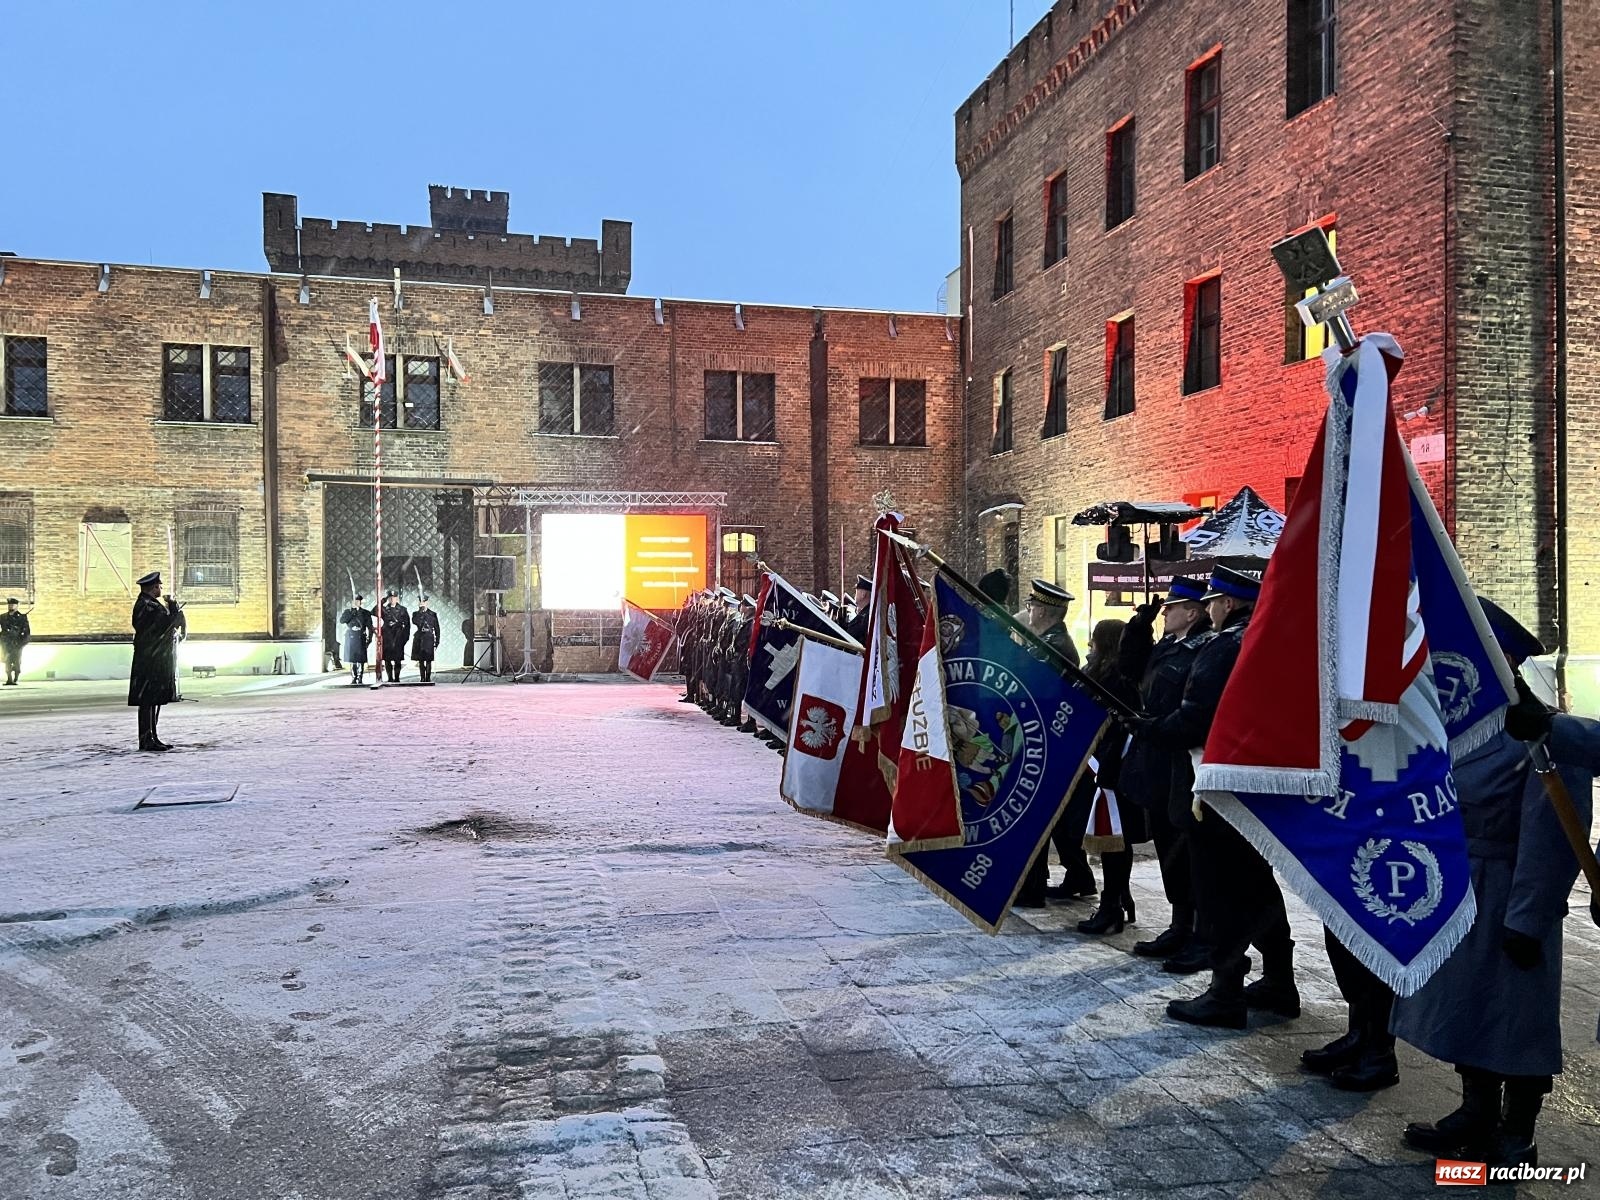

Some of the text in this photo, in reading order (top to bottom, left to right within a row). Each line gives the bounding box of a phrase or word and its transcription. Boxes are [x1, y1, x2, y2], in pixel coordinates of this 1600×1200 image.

[944, 662, 1018, 696] WA PSP
[1050, 701, 1074, 737] 1998
[961, 853, 993, 890] 1858
[1386, 861, 1416, 897] P
